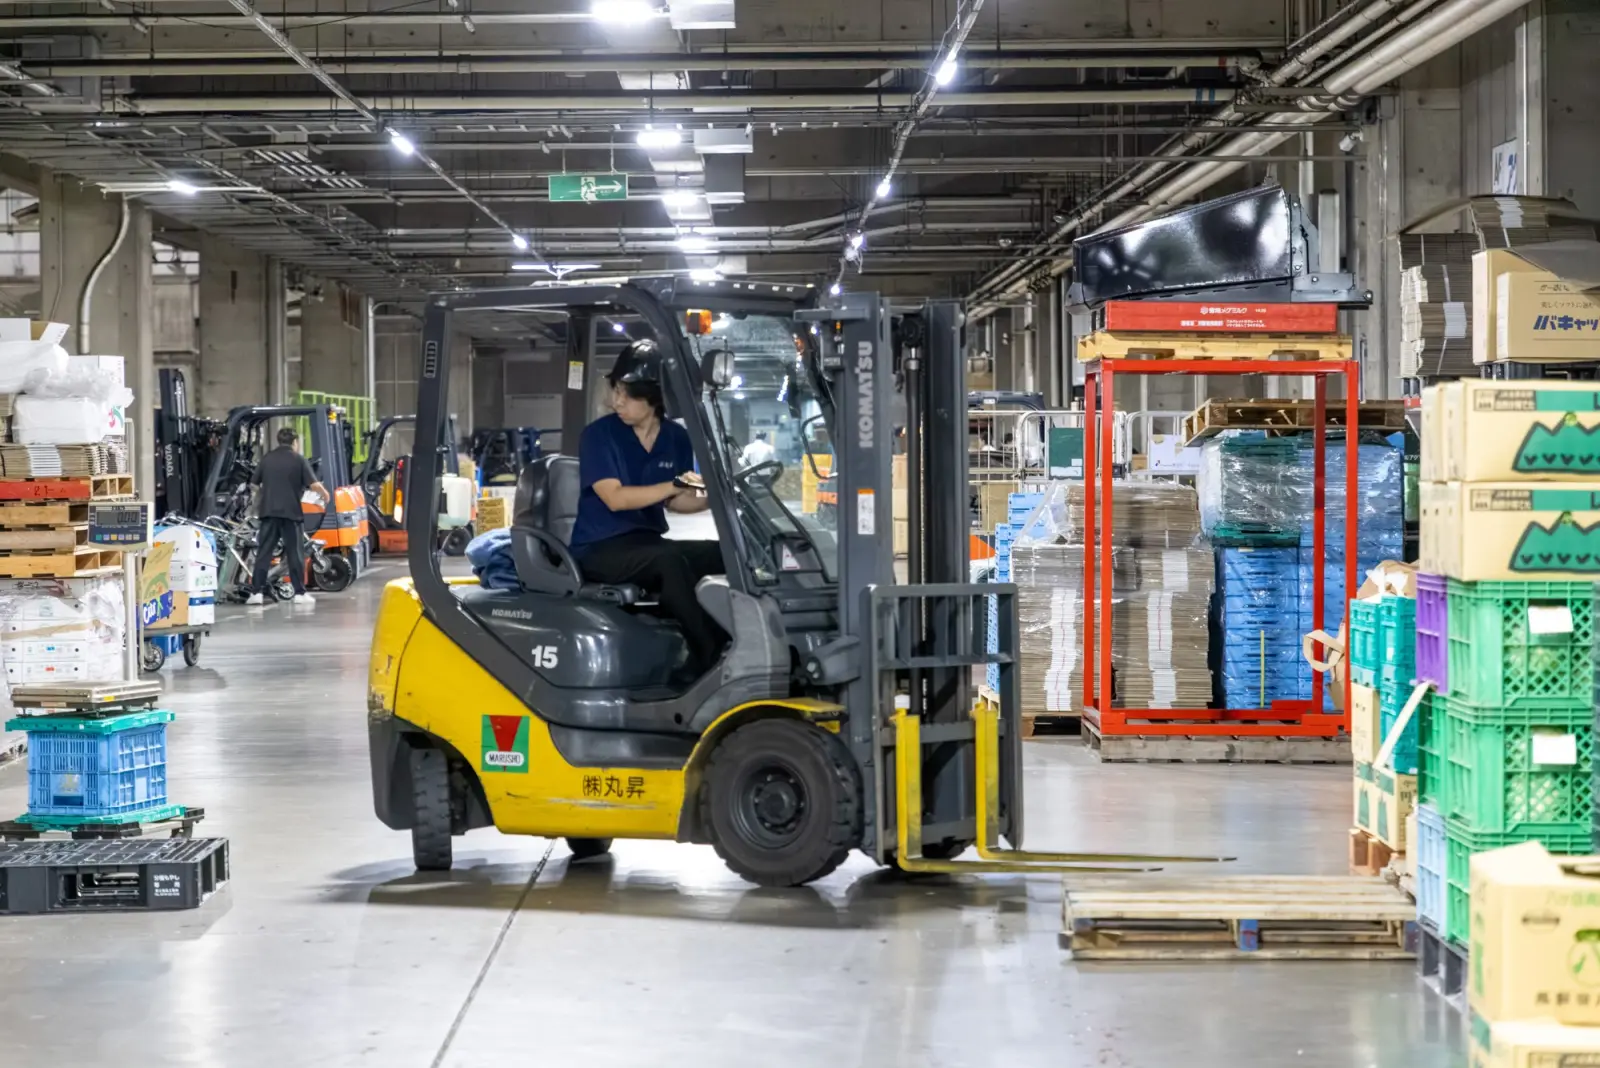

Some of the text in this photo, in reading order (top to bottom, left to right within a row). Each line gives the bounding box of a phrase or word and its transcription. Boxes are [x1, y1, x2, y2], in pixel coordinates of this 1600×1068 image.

[855, 341, 874, 448] KOMATSU
[164, 443, 174, 478] TOYOTA
[491, 608, 533, 619] KOMATSU
[531, 644, 558, 669] 15
[489, 753, 521, 765] MARUSHO
[583, 774, 646, 799] (株)丸昇
